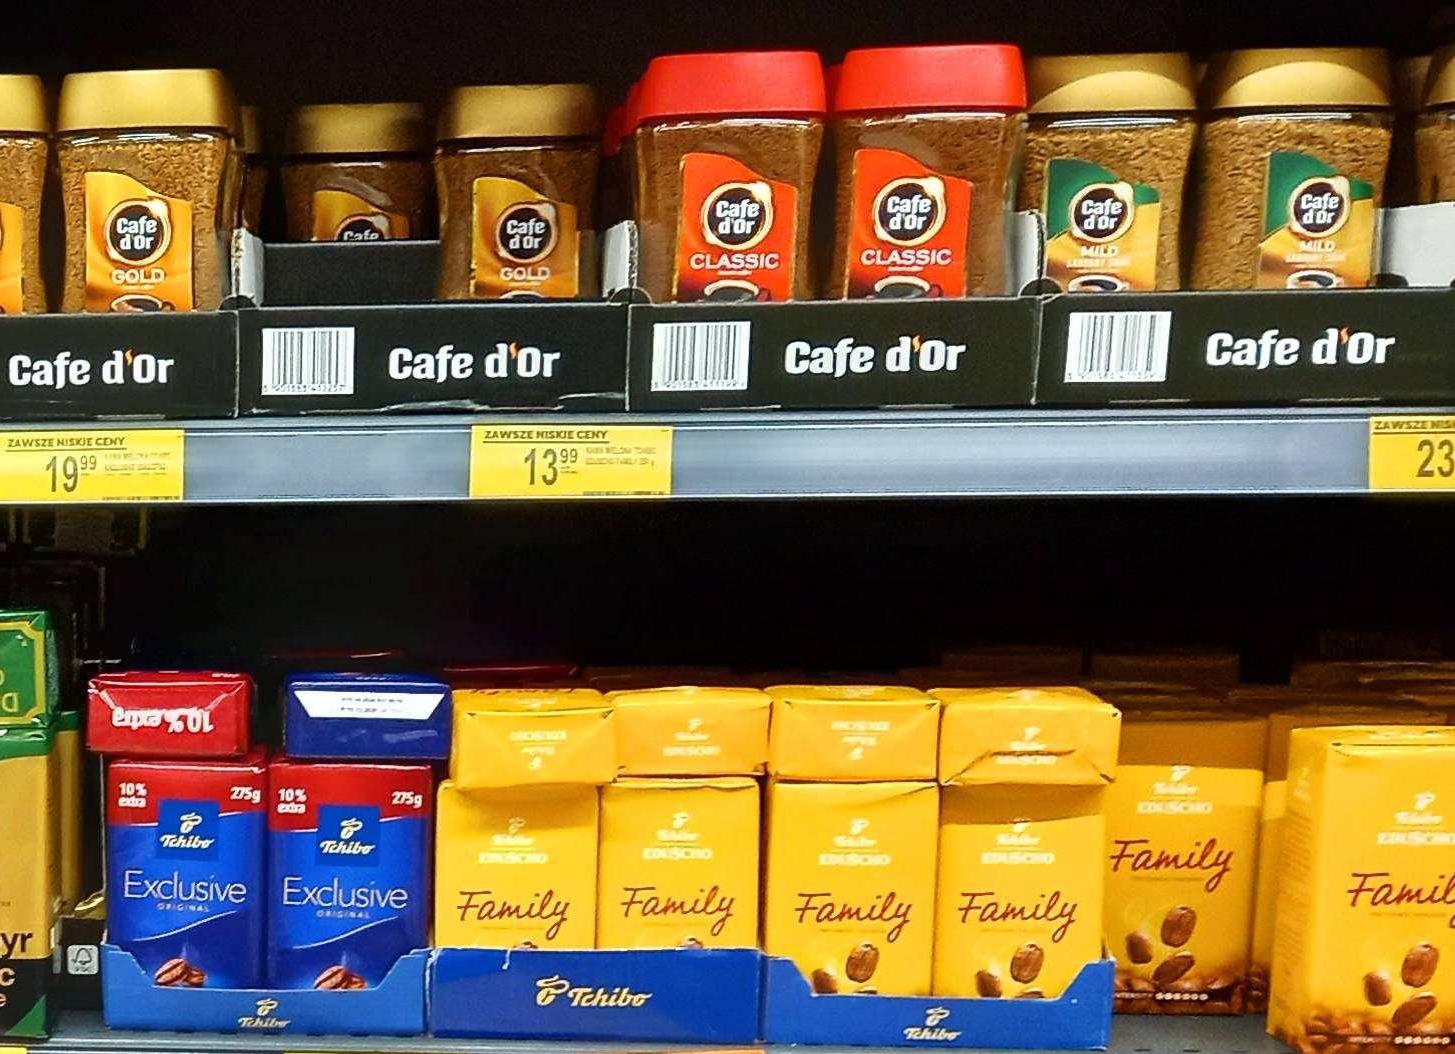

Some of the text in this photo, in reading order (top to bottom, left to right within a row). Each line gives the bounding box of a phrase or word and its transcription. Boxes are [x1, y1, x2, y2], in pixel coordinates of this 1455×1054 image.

[1079, 246, 1118, 258] MILD
[1297, 240, 1336, 254] MILD
[689, 252, 780, 271] CLASSIC
[860, 248, 952, 267] CLASSIC
[111, 268, 165, 284] GOLD
[500, 267, 550, 282] GOLD
[1206, 329, 1395, 369] Cafe d'Or
[388, 344, 560, 383] Cafe d'Or
[784, 338, 966, 378] Cafe d'Or
[8, 350, 174, 389] Cafe d'Or
[1375, 421, 1426, 430] ZAWSZE
[46, 456, 78, 491] 19
[80, 456, 97, 470] 99
[524, 449, 558, 485] 13
[560, 449, 578, 463] 99
[119, 782, 147, 796] 10%
[230, 787, 261, 803] 275g
[278, 789, 306, 802] 10%
[118, 795, 146, 808] extra
[277, 801, 305, 814] extra
[392, 791, 422, 808] 275g
[160, 834, 214, 849] Tchibo
[320, 841, 374, 855] Tchibo
[643, 848, 712, 859] EDUSCHO
[1110, 838, 1232, 892] Family
[124, 870, 246, 901] Exclusive
[283, 877, 408, 909] Exclusive
[157, 902, 210, 912] ORIGINAL
[316, 910, 370, 918] ORIGINAL
[457, 890, 570, 940] Family
[621, 886, 735, 936] Family
[795, 892, 911, 942] Family
[958, 891, 1077, 942] Family
[567, 987, 652, 1007] Tchibo
[238, 1017, 290, 1028] Tchibo
[903, 1028, 960, 1040] Tchibo
